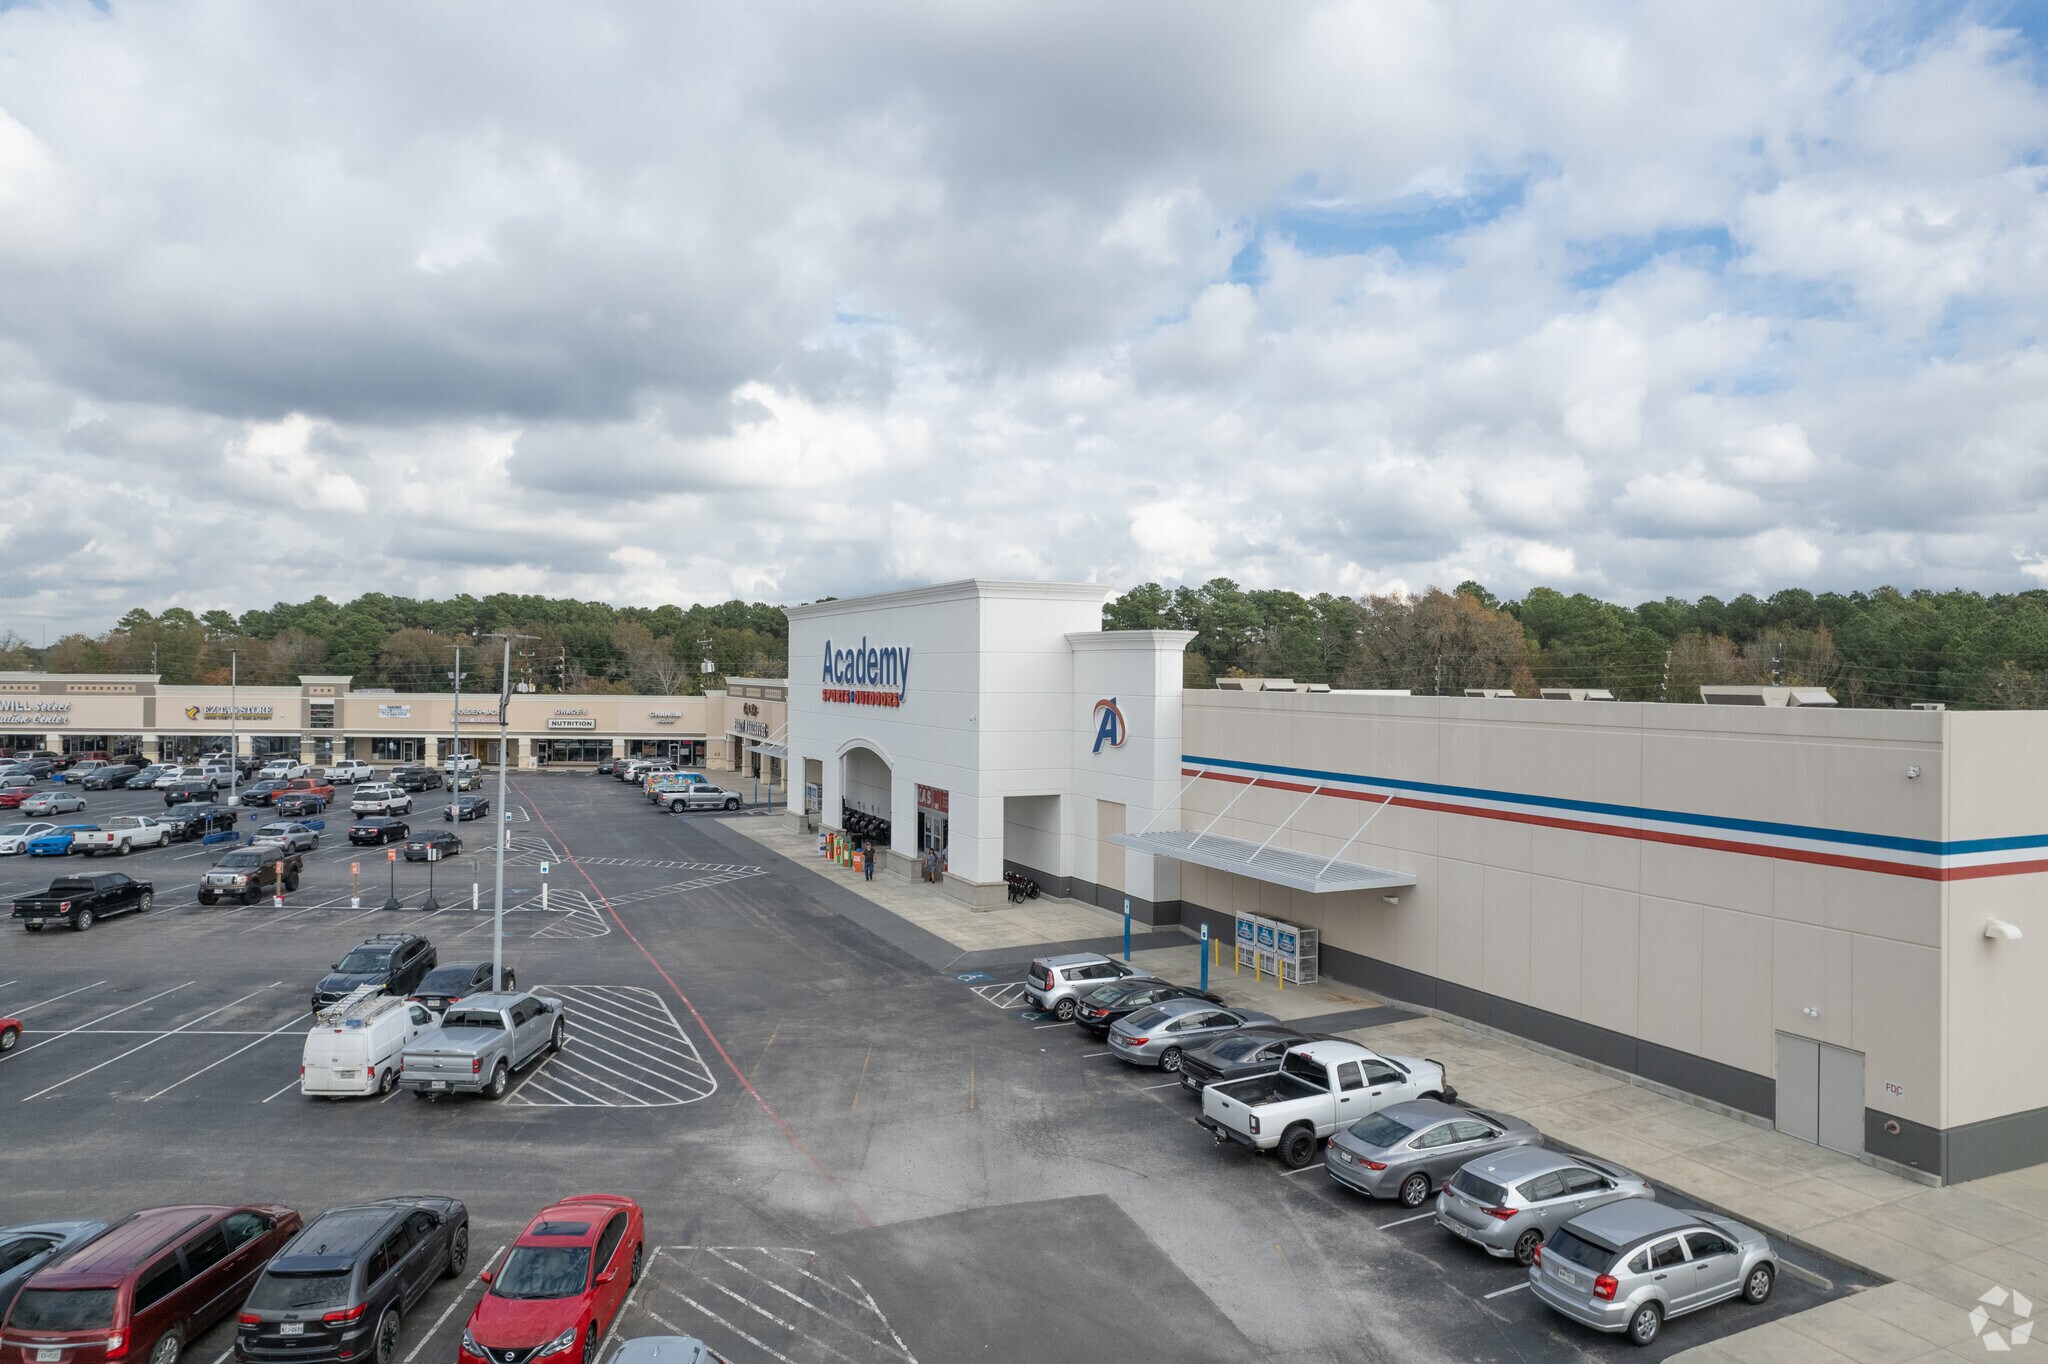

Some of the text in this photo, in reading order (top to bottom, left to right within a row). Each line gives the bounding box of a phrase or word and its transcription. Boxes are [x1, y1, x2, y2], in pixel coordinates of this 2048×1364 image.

[822, 635, 910, 702] Academy
[822, 688, 850, 703] SPORTS
[854, 690, 900, 708] OUTDOORS
[0, 700, 71, 711] WILL Select
[203, 706, 273, 714] EZ TAG STORE
[33, 713, 69, 724] Center
[1886, 1082, 1903, 1096] FDC
